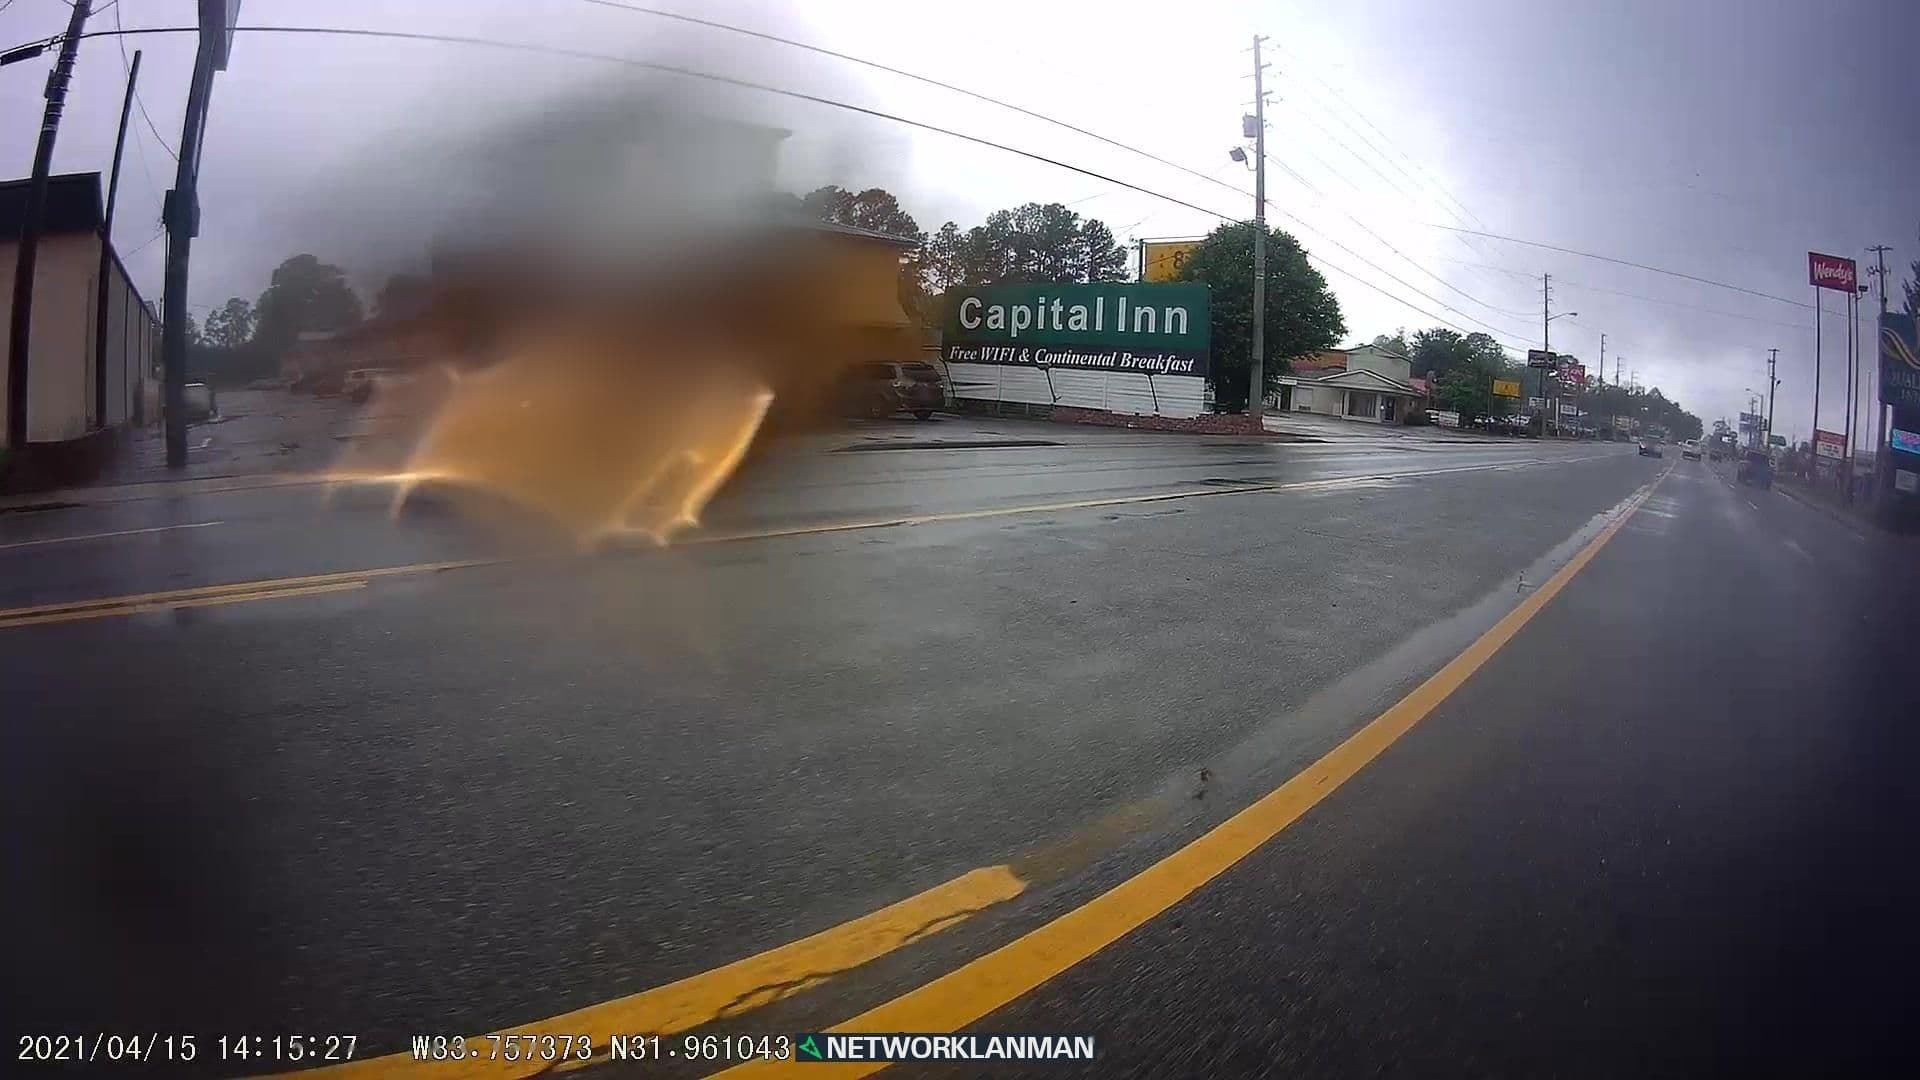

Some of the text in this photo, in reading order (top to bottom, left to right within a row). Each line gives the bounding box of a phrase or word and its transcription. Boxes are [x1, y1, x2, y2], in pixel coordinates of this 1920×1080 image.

[959, 296, 1188, 338] Capital Inn
[949, 345, 1195, 375] Free WIFI & Continental Breakfast
